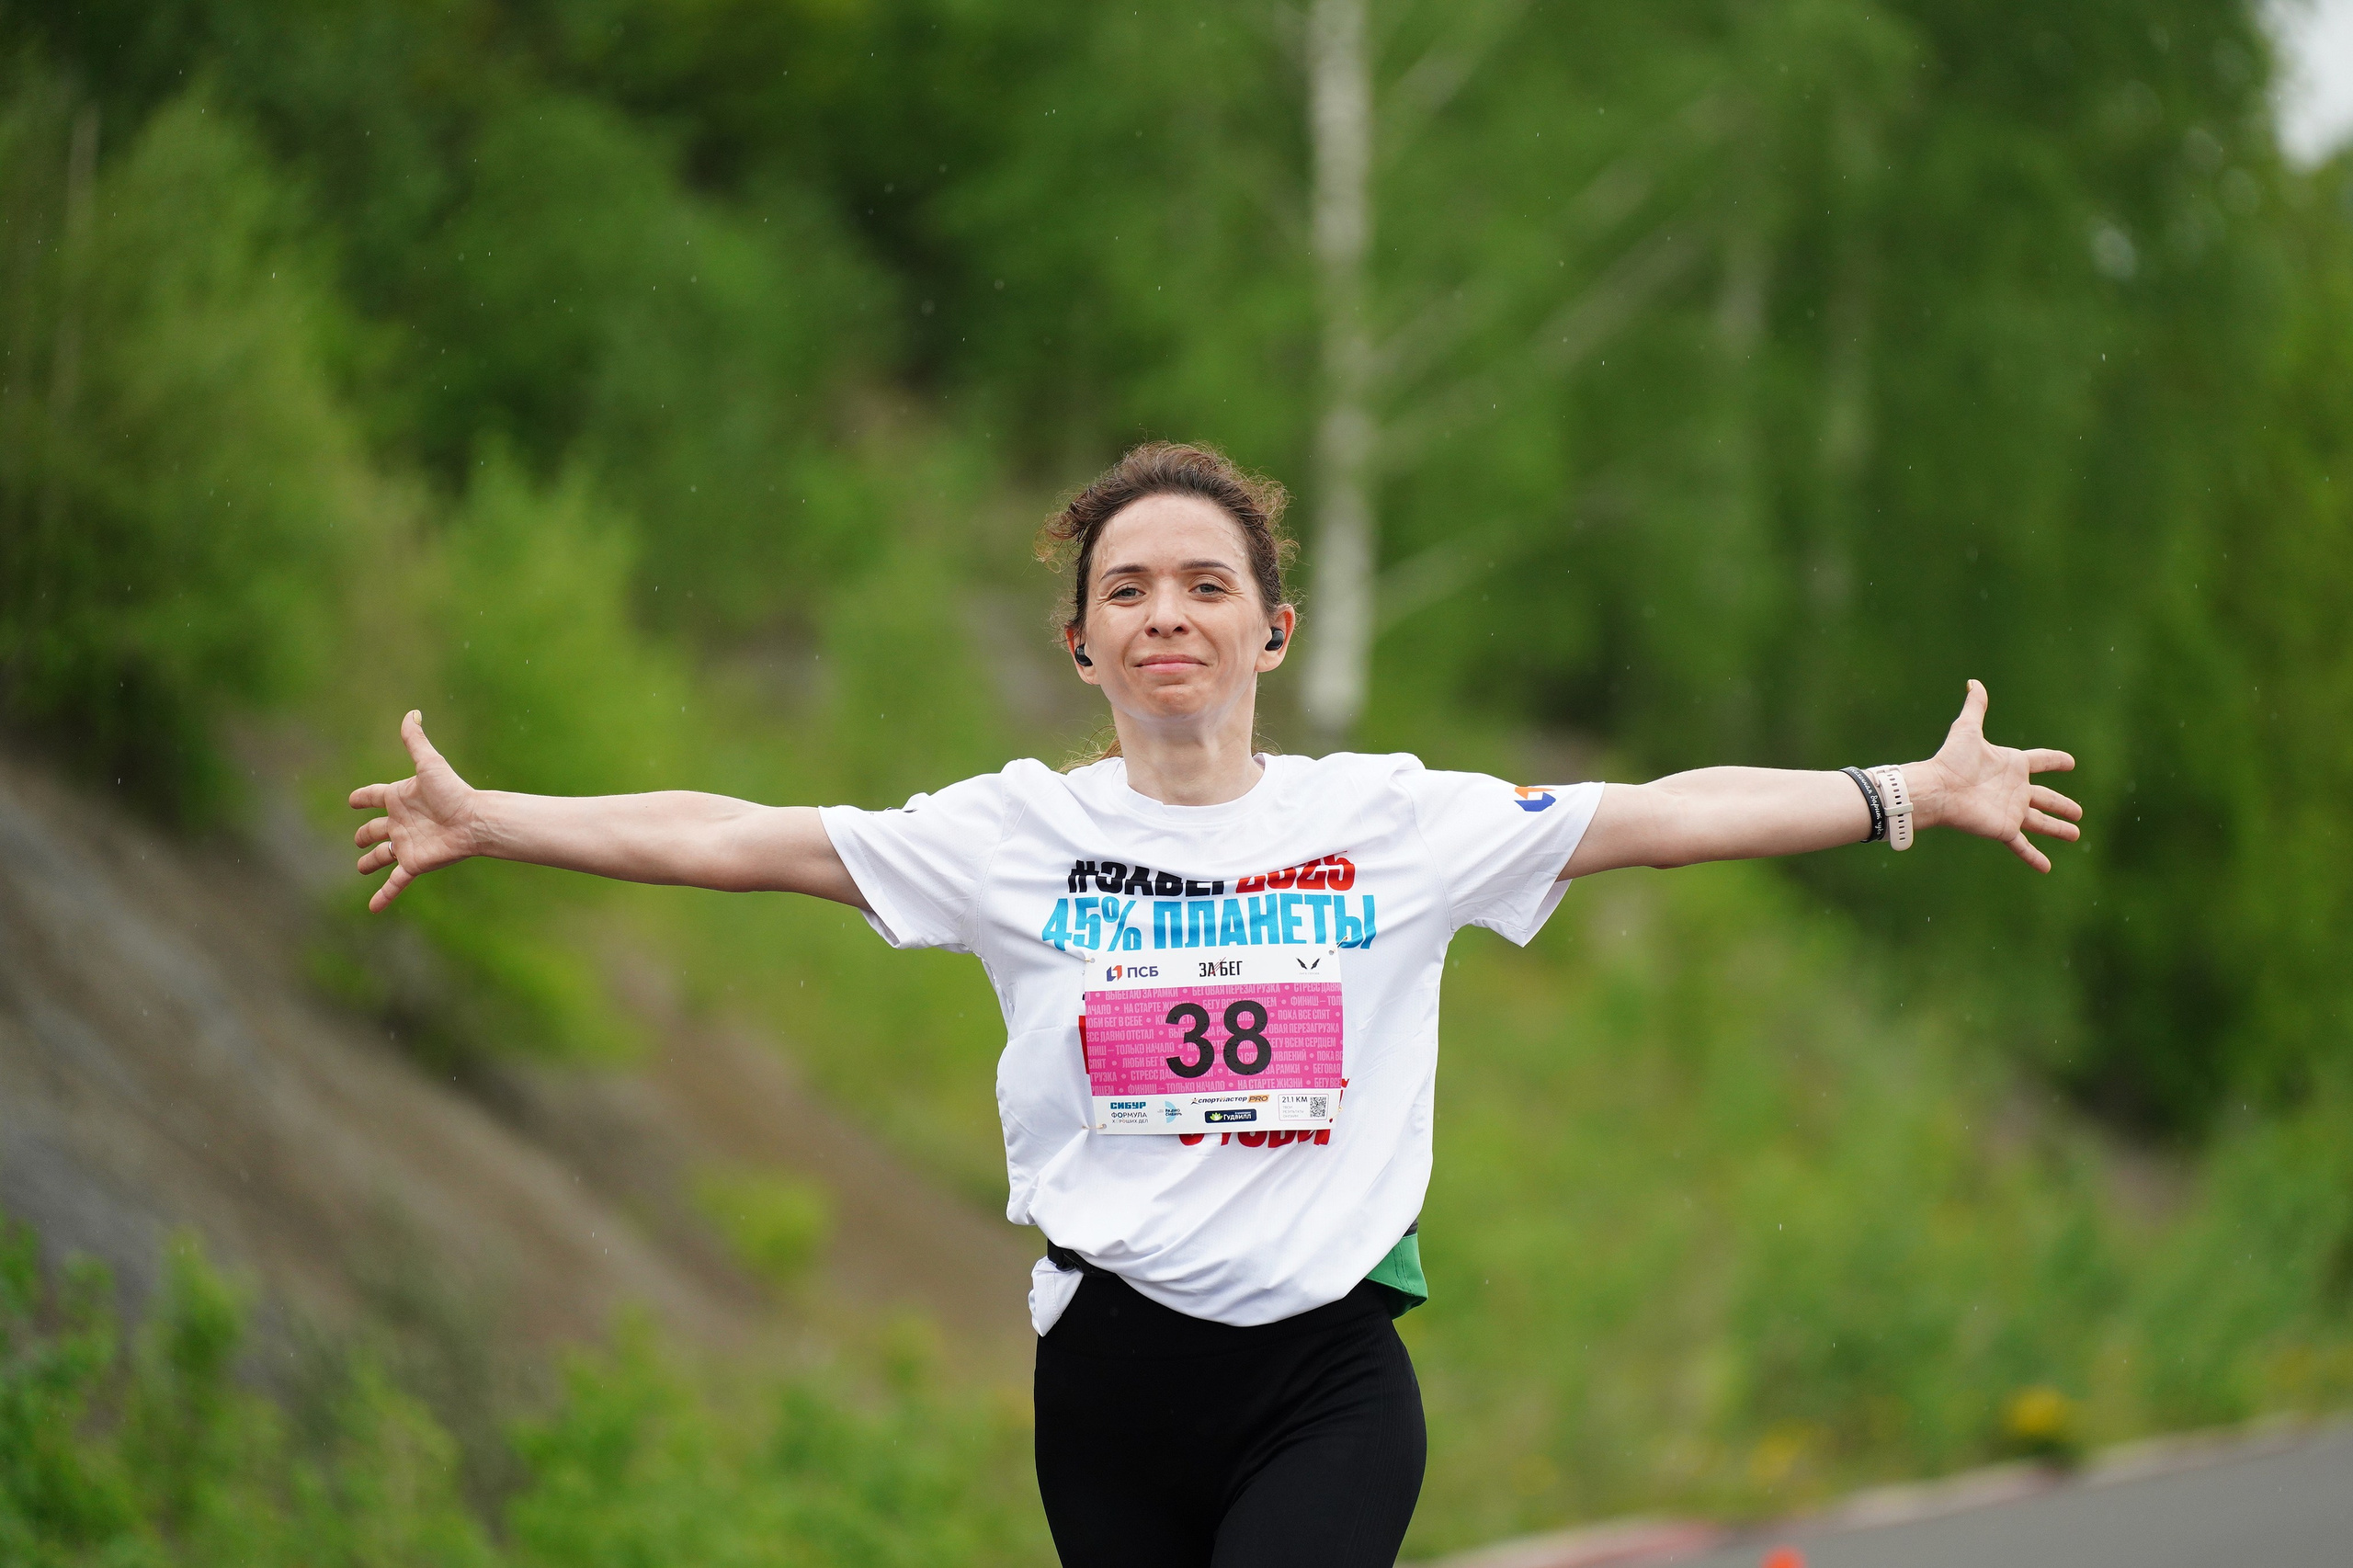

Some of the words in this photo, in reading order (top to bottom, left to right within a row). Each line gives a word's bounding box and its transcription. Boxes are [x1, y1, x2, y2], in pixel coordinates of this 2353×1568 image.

[1041, 895, 1142, 952] 45%
[1153, 893, 1377, 950] ПЛАНЕТЫ
[1127, 966, 1159, 978] ПСБ
[1142, 989, 1153, 999] ЗА
[1153, 987, 1178, 998] РАМКИ
[1202, 998, 1221, 1010] БЕГУ
[1290, 995, 1319, 1006] ФИНИШ
[1123, 1003, 1134, 1014] НА
[1134, 1001, 1162, 1014] СТАРТЕ
[1278, 1009, 1297, 1020] ПОКА
[1298, 1009, 1312, 1020] ВСЕ
[1312, 1009, 1330, 1020] СПЯТ
[1104, 1017, 1117, 1028] БЕГ
[1118, 1017, 1124, 1027] В
[1124, 1016, 1143, 1027] СЕБЕ
[1289, 1022, 1340, 1034] ПЕРЕЗАГРУЗКА
[1100, 1030, 1125, 1043] ДАВНО
[1126, 1028, 1154, 1040] ОТСТАЛ
[1165, 1000, 1272, 1078] 38
[1115, 1043, 1144, 1055] ТОЛЬКО
[1145, 1042, 1175, 1053] НАЧАЛО
[1284, 1037, 1304, 1048] ВСЕМ
[1304, 1036, 1336, 1049] СЕРДЦЕМ
[1122, 1057, 1144, 1068] ЛЮБИ
[1145, 1056, 1159, 1067] БЕГ
[1159, 1056, 1165, 1066] В
[1316, 1050, 1335, 1062] ПОКА
[1275, 1063, 1301, 1074] РАМКИ
[1313, 1062, 1341, 1074] БЕГОВАЯ
[1130, 1069, 1159, 1082] СТРЕСС
[1127, 1084, 1157, 1095] ФИНИШ
[1165, 1082, 1195, 1093] ТОЛЬКО
[1196, 1080, 1225, 1092] НАЧАЛО
[1237, 1079, 1248, 1090] НА
[1248, 1078, 1276, 1089] СТАРТЕ
[1276, 1077, 1303, 1088] ЖИЗНИ
[1313, 1077, 1329, 1088] БЕГУ
[1109, 1101, 1146, 1110] СИБУР
